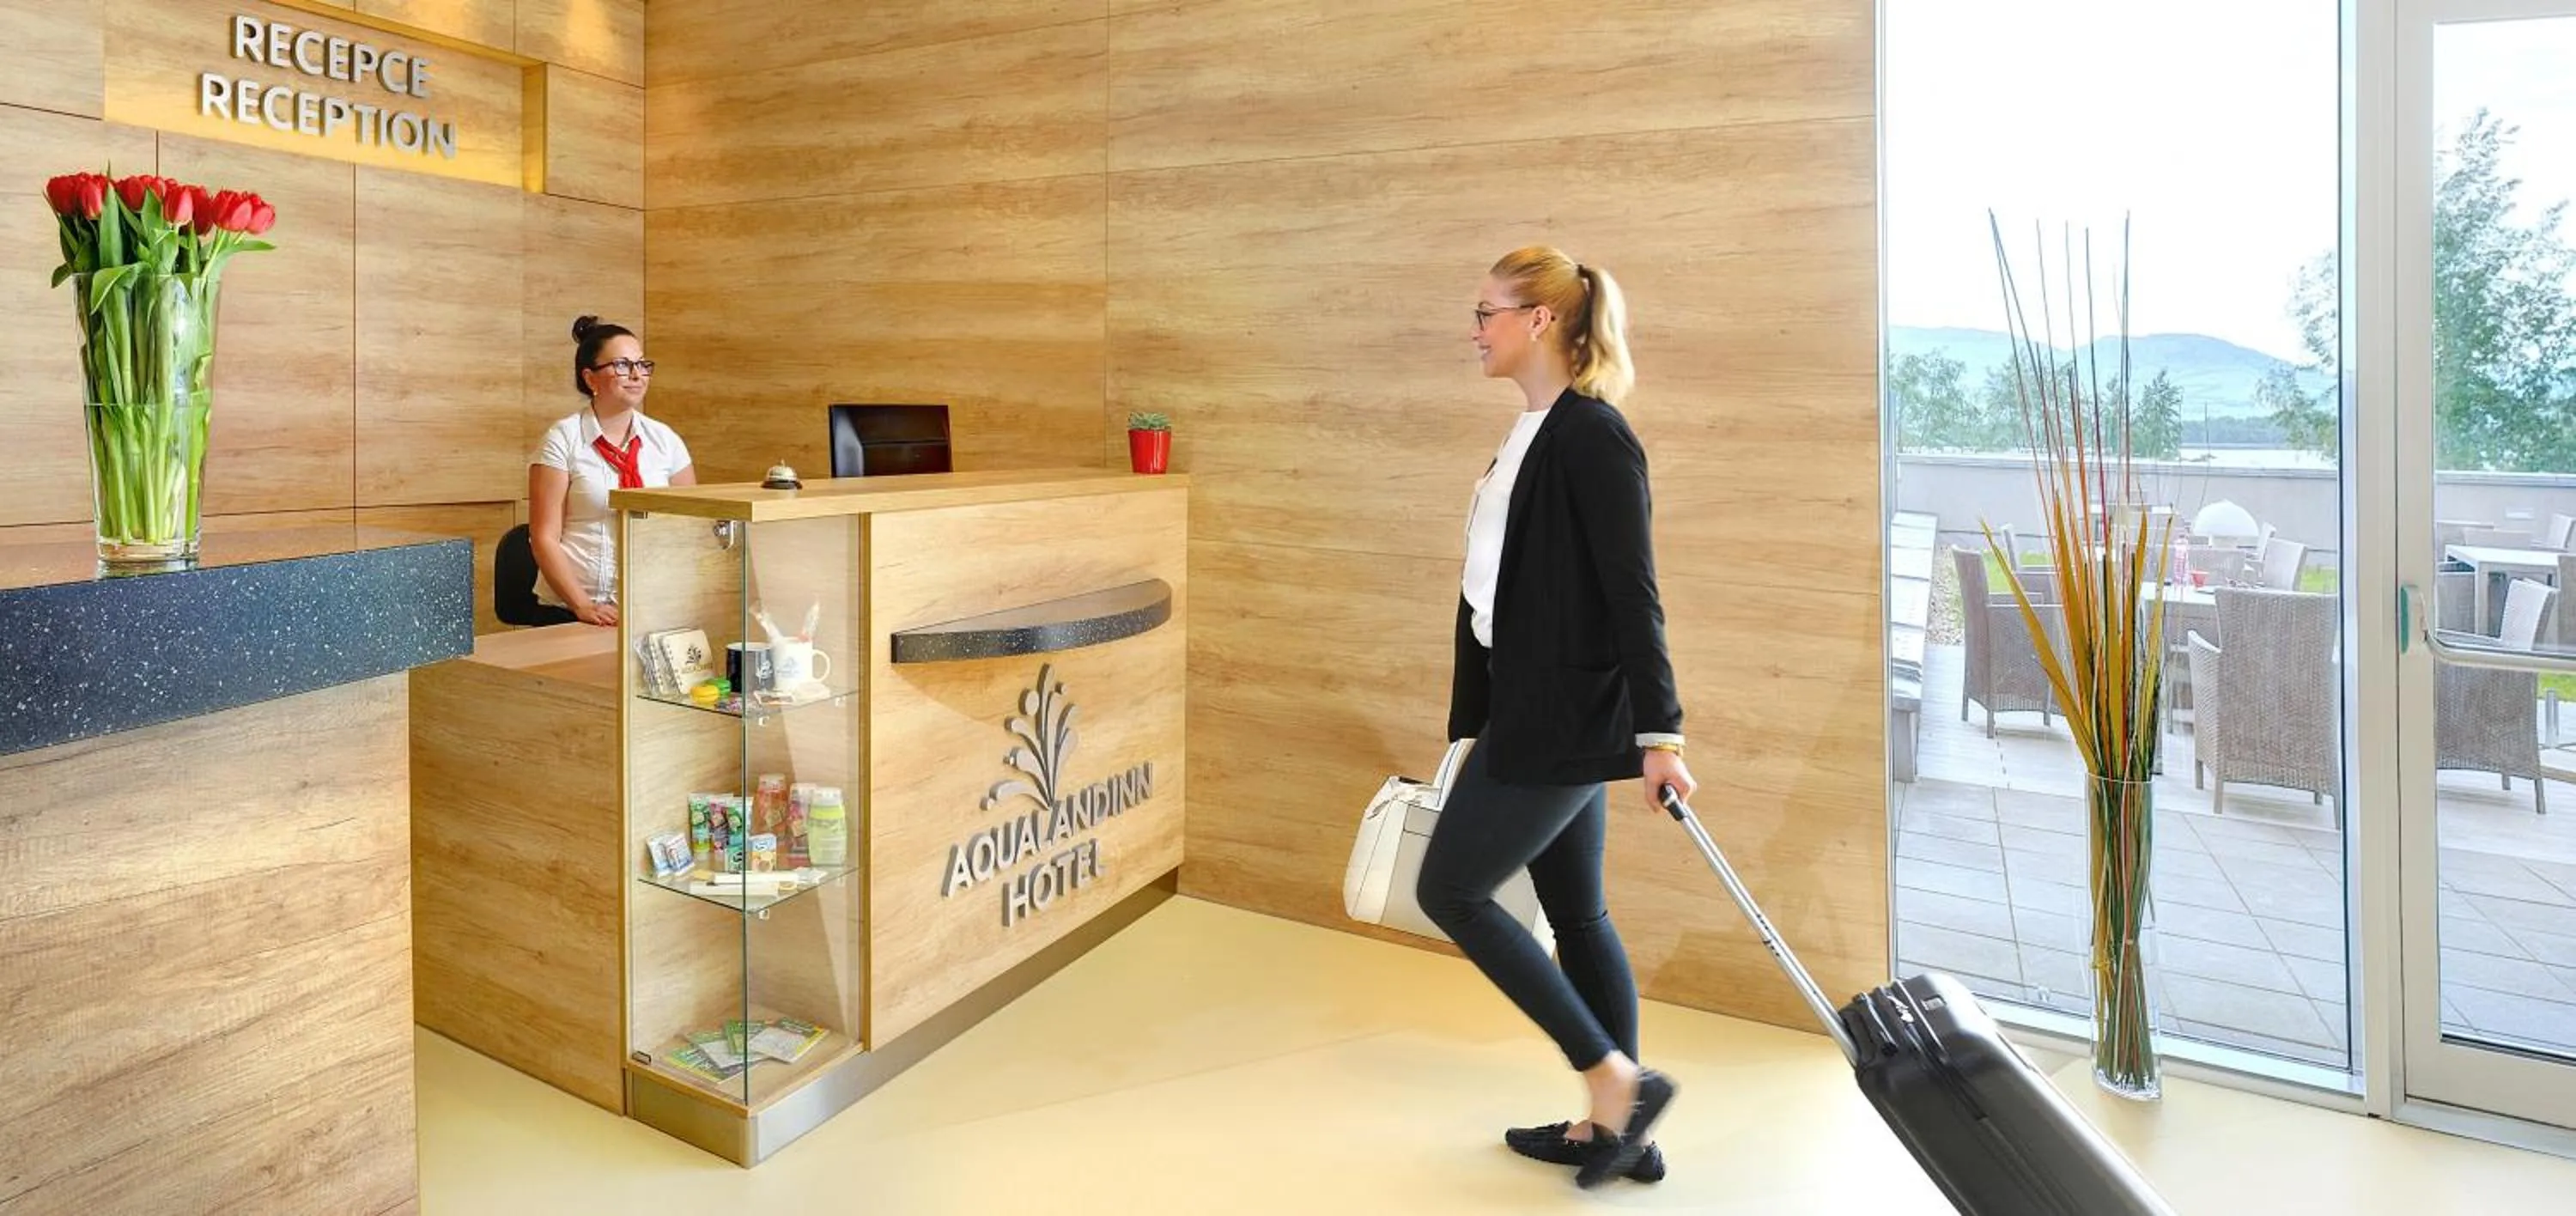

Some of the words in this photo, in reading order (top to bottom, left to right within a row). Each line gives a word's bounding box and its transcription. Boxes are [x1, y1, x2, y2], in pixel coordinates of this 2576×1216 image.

[231, 15, 432, 98] RECEPCE
[198, 72, 457, 159] RECEPTION
[941, 761, 1153, 898] AQUALANDINN
[1002, 837, 1106, 927] HOTEL
